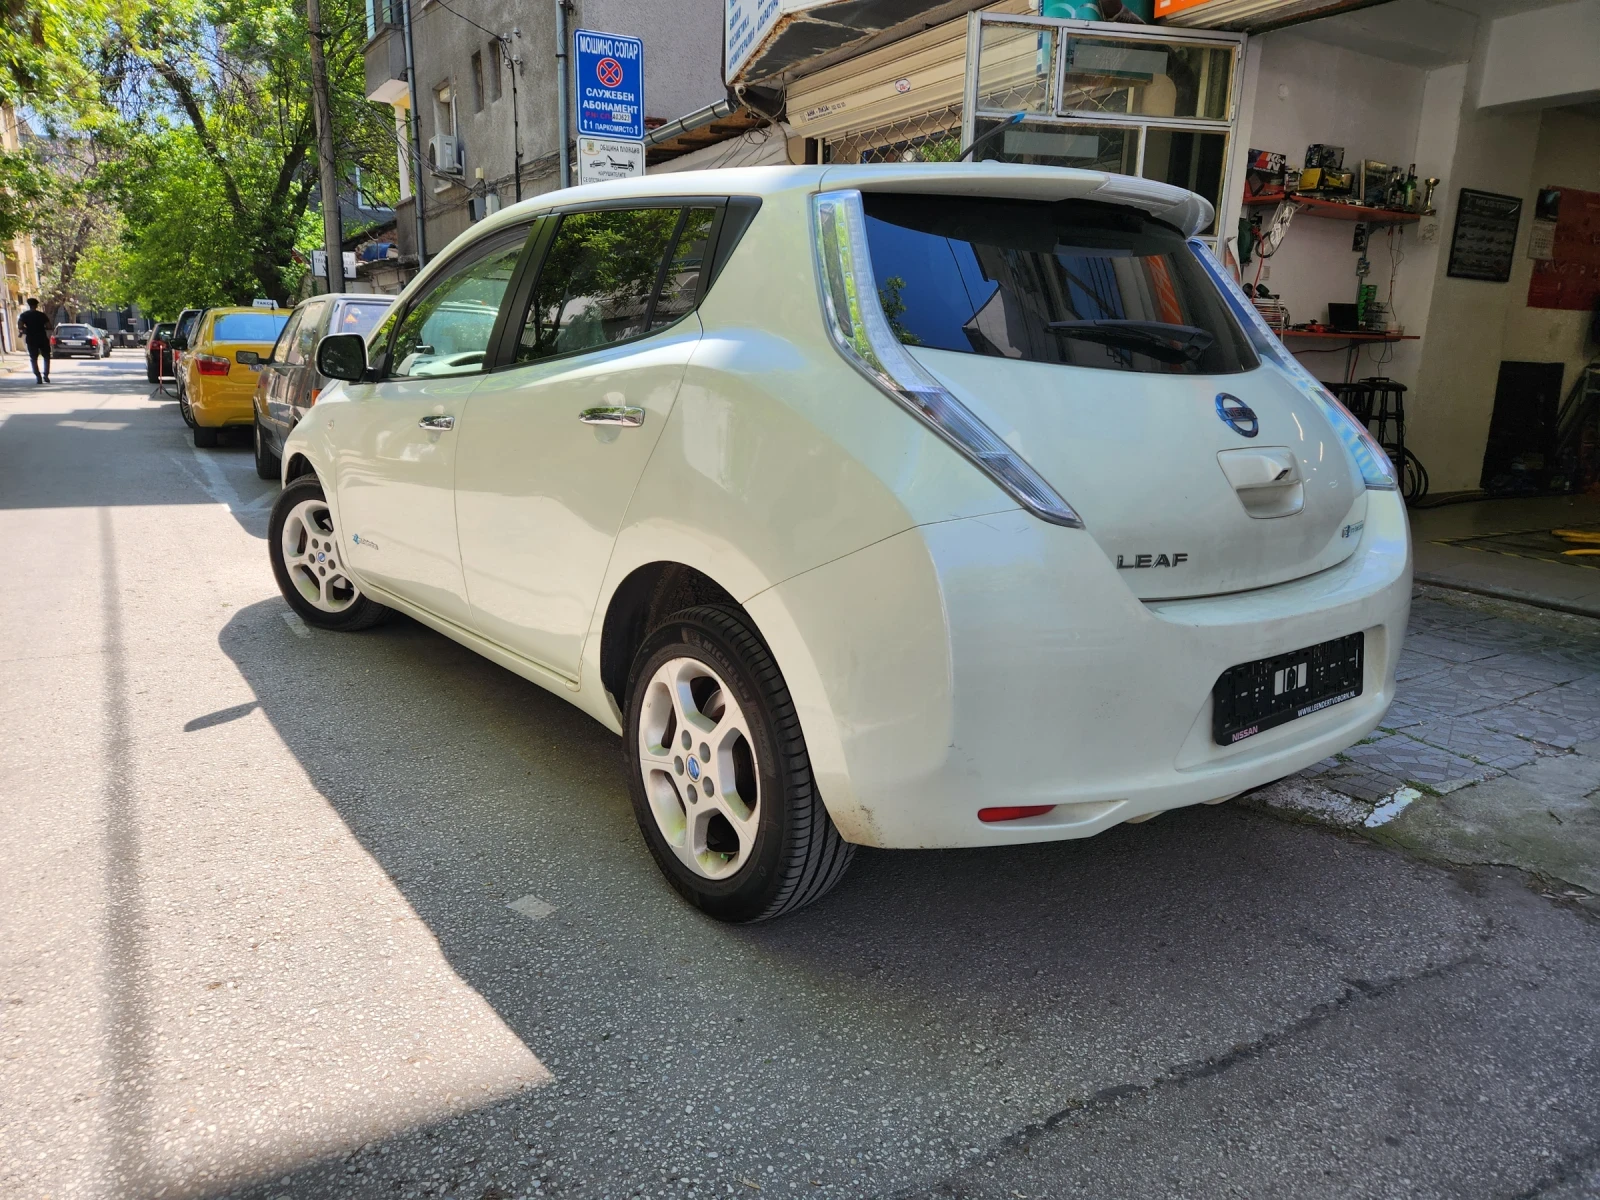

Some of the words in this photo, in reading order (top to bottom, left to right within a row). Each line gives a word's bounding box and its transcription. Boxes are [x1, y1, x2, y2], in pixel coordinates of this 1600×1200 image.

[585, 87, 634, 102] СЛУЖЕБЕН
[583, 100, 638, 114] АБОНАМЕНТ
[589, 120, 593, 129] 1
[595, 123, 633, 134] ПАРКОМЯСТО
[1116, 553, 1188, 569] LEAF
[1231, 725, 1258, 742] NISSAN
